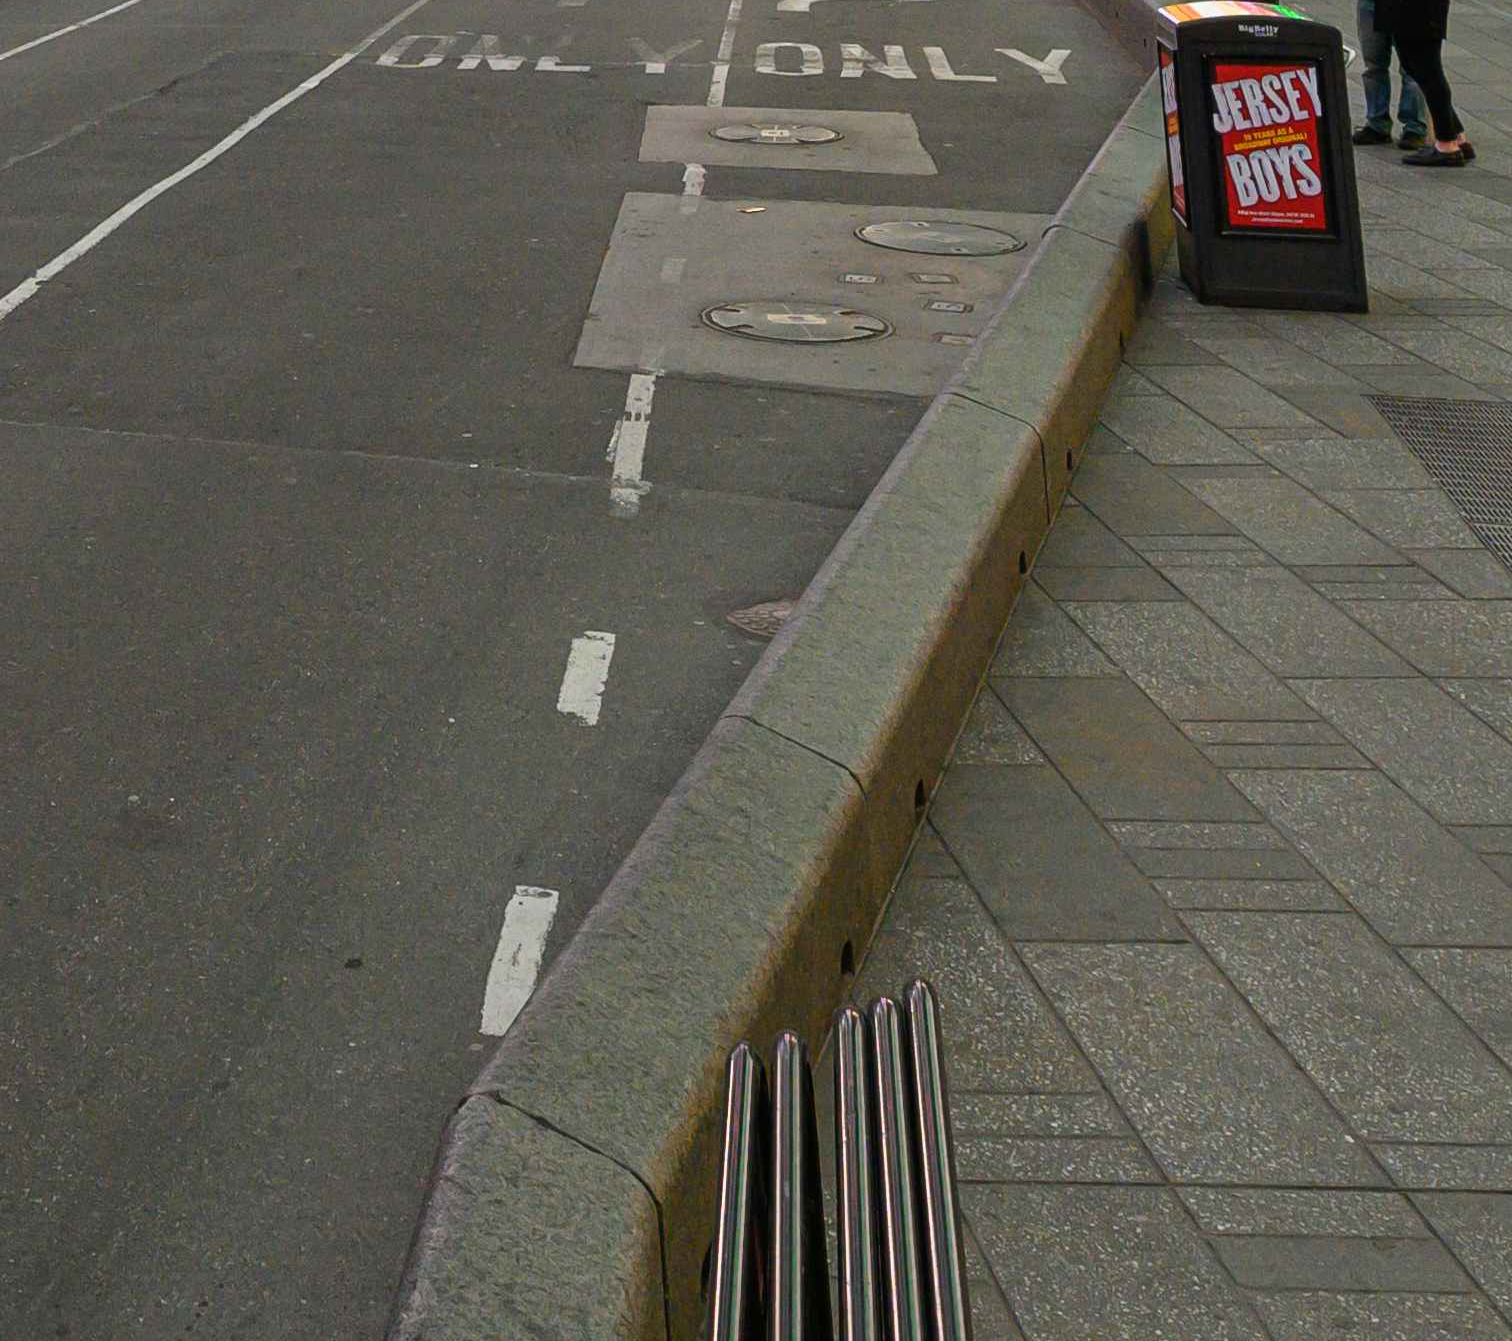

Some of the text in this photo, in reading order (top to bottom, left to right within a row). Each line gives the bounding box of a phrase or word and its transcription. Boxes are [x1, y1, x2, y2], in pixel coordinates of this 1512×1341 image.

[376, 33, 1072, 84] ONLY ONLY
[1211, 67, 1324, 134] JERSEY
[1227, 143, 1323, 208] BOYS
